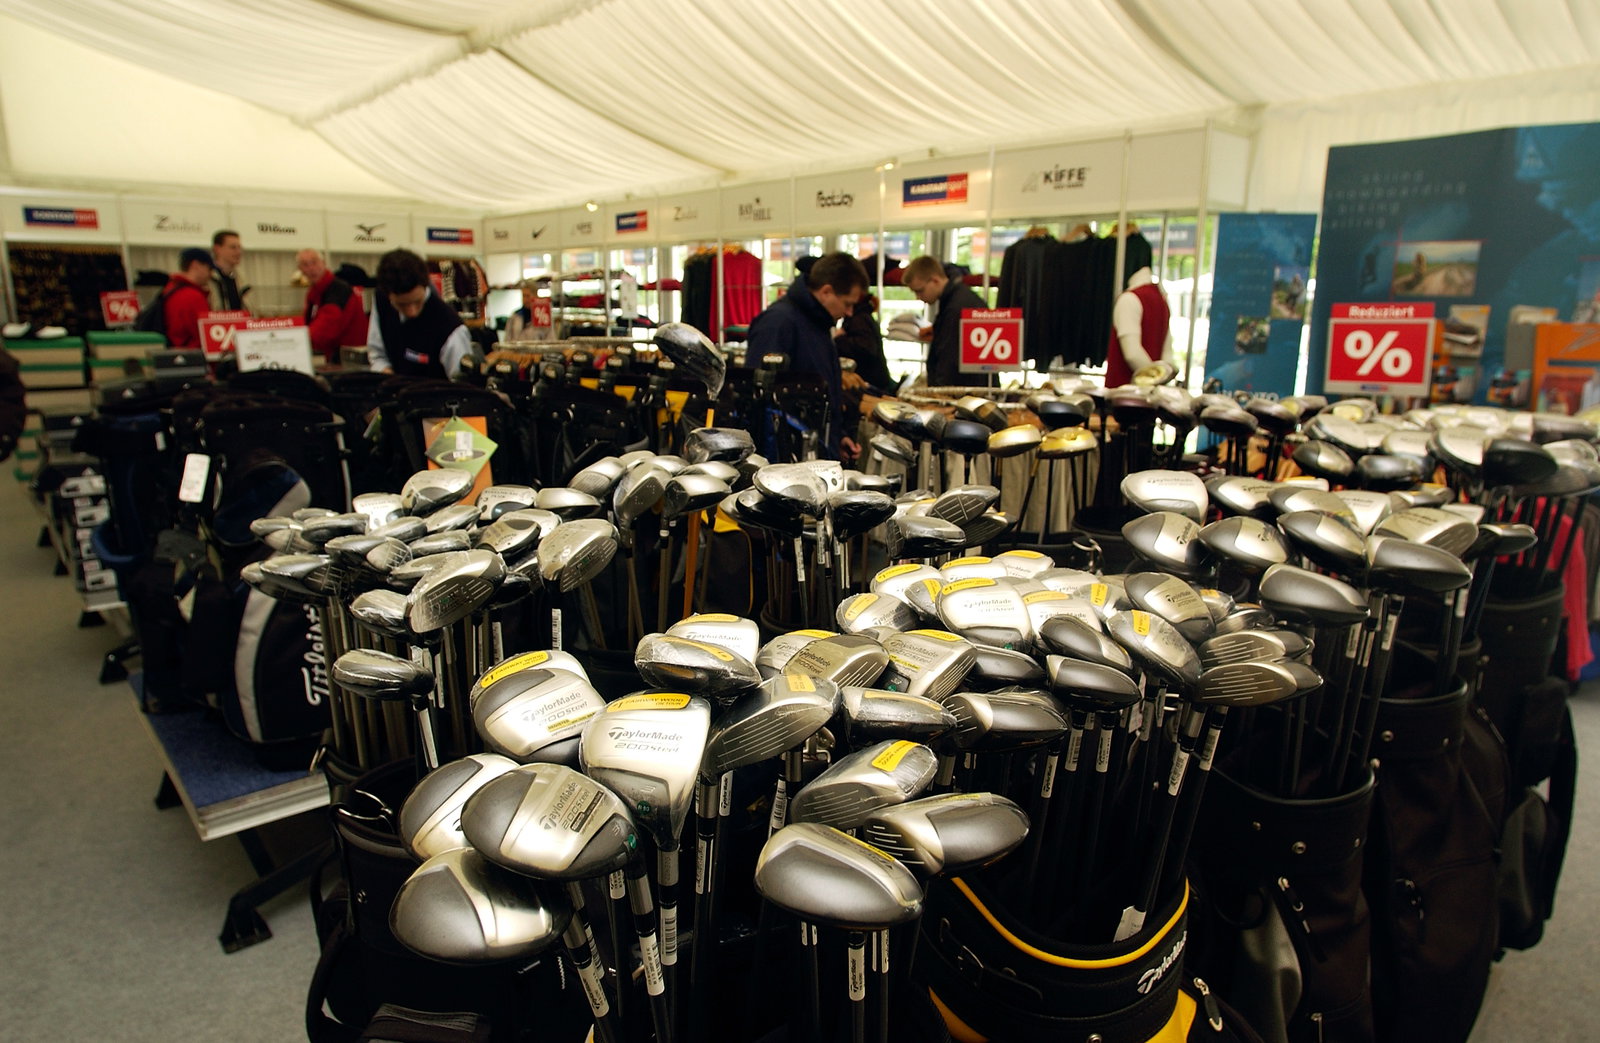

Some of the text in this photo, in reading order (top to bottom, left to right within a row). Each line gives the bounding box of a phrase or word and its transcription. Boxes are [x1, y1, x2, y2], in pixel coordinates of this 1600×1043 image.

[971, 310, 1012, 319] Reduziert
[1348, 305, 1415, 318] Reduziert
[969, 327, 1012, 361] %
[1343, 329, 1413, 377] %
[521, 691, 582, 722] TaylorMade
[608, 726, 683, 741] TaylorMade
[539, 781, 579, 831] TaylorMade
